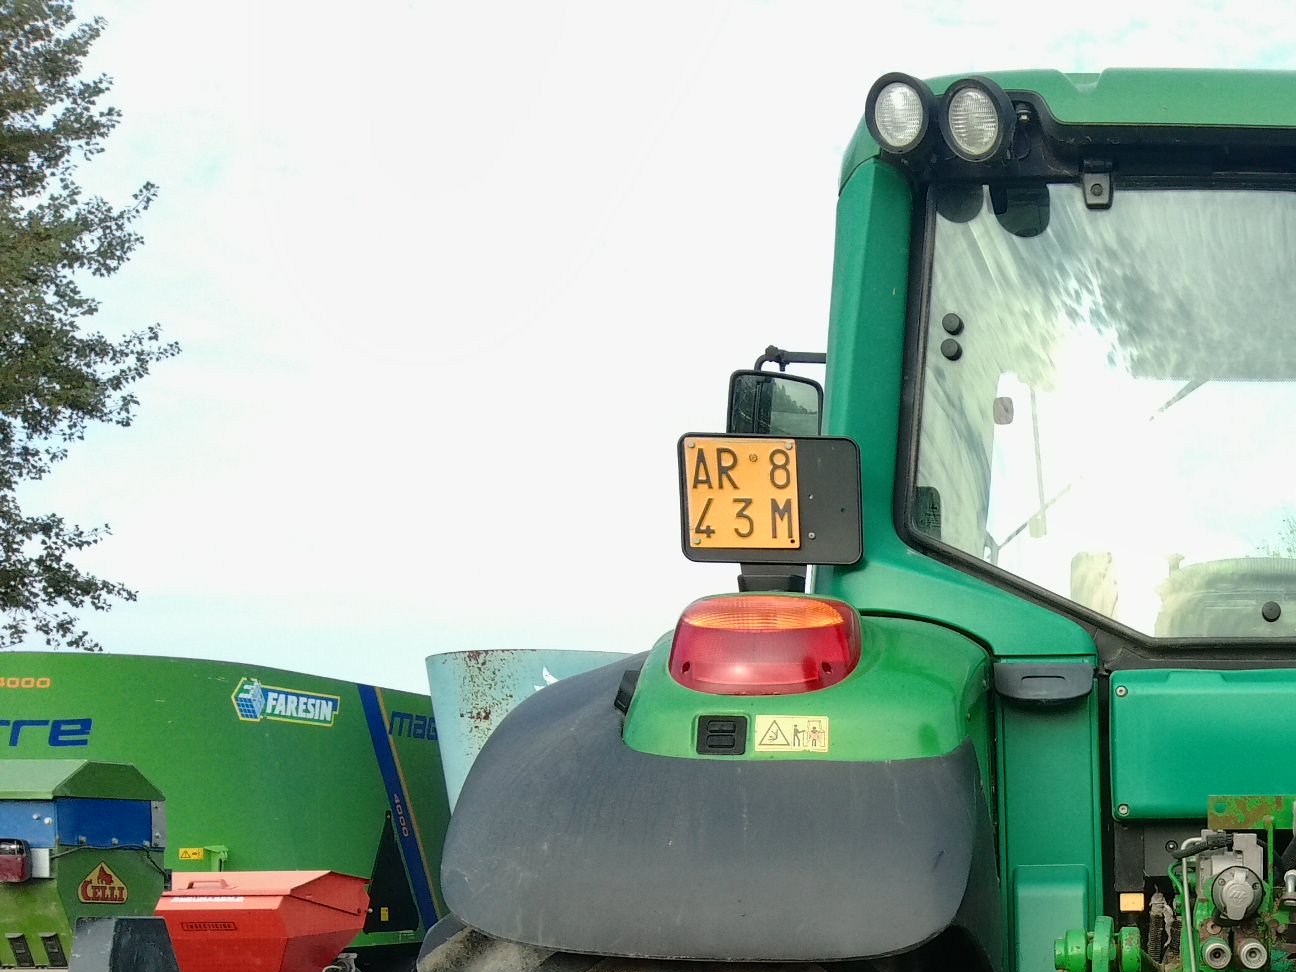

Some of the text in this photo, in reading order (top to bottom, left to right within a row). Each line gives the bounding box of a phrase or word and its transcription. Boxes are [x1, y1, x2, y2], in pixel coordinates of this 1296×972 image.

[692, 447, 791, 490] AR 8
[265, 691, 333, 722] FARESIN
